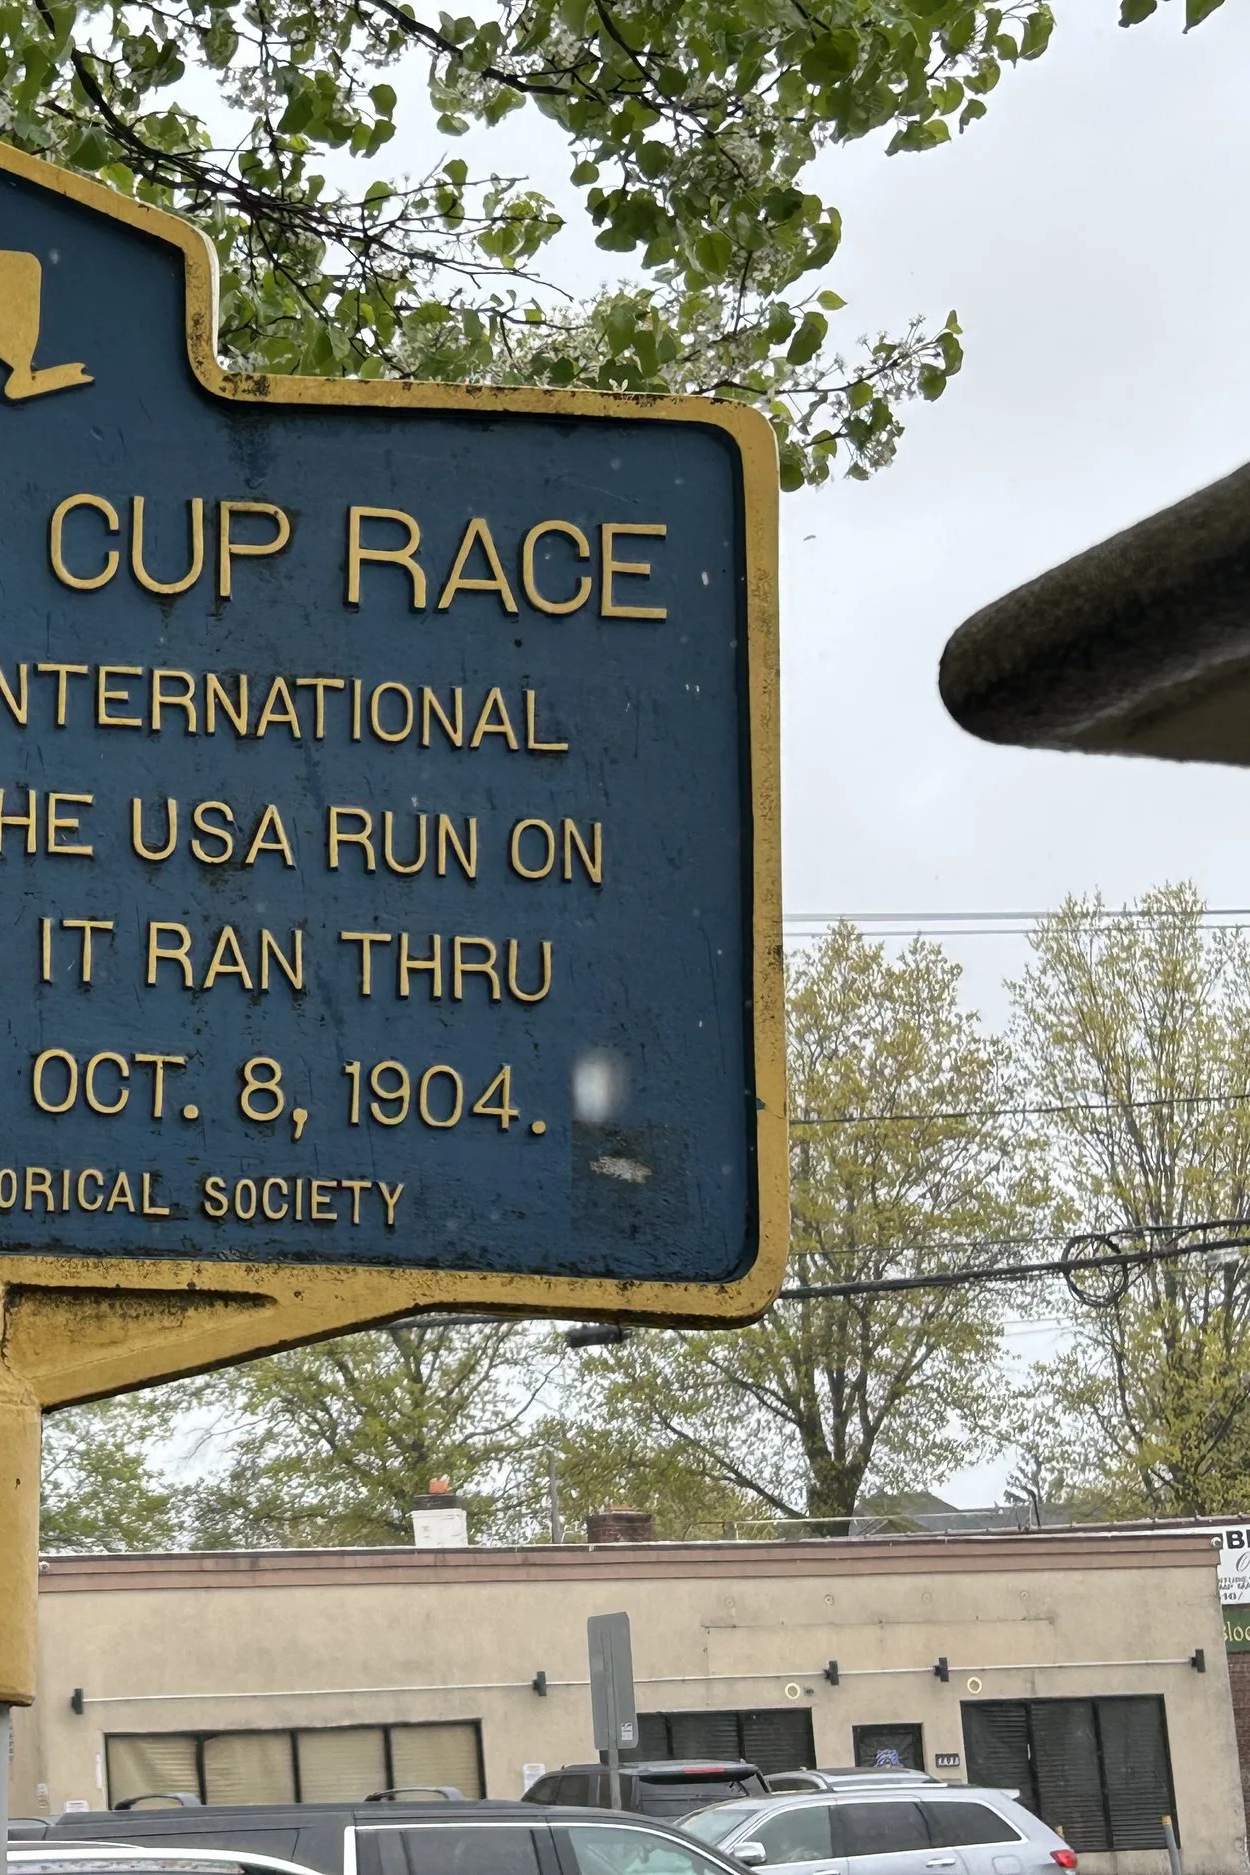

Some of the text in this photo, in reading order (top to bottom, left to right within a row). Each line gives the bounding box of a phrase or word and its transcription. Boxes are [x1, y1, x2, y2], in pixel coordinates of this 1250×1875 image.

[51, 494, 290, 596] CUP
[349, 506, 667, 618] RACE
[134, 799, 292, 864] USA
[330, 807, 477, 877] RUN
[512, 819, 601, 882] ON
[43, 919, 113, 981] IT
[148, 922, 302, 989] RAN
[342, 932, 551, 1001] THRU
[34, 1049, 198, 1118] OCT.
[241, 1057, 307, 1138] 8,
[346, 1061, 546, 1133] 1904.
[205, 1177, 402, 1224] SOCIETY
